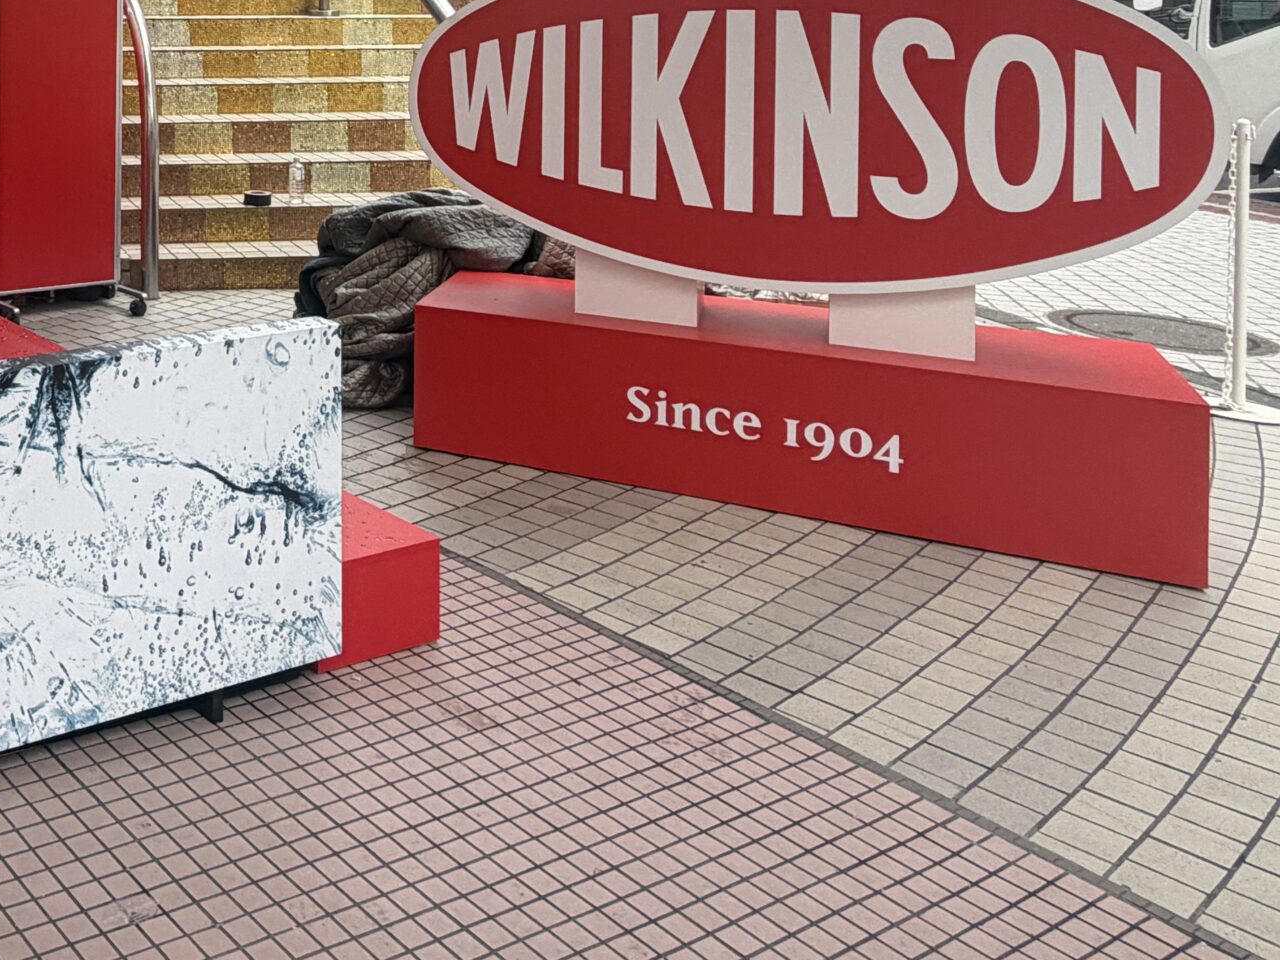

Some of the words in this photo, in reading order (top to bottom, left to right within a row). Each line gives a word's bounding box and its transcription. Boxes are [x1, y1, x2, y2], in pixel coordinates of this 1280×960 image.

[449, 9, 1162, 221] WILKINSON
[625, 385, 762, 442] Since
[782, 417, 905, 475] 1904
